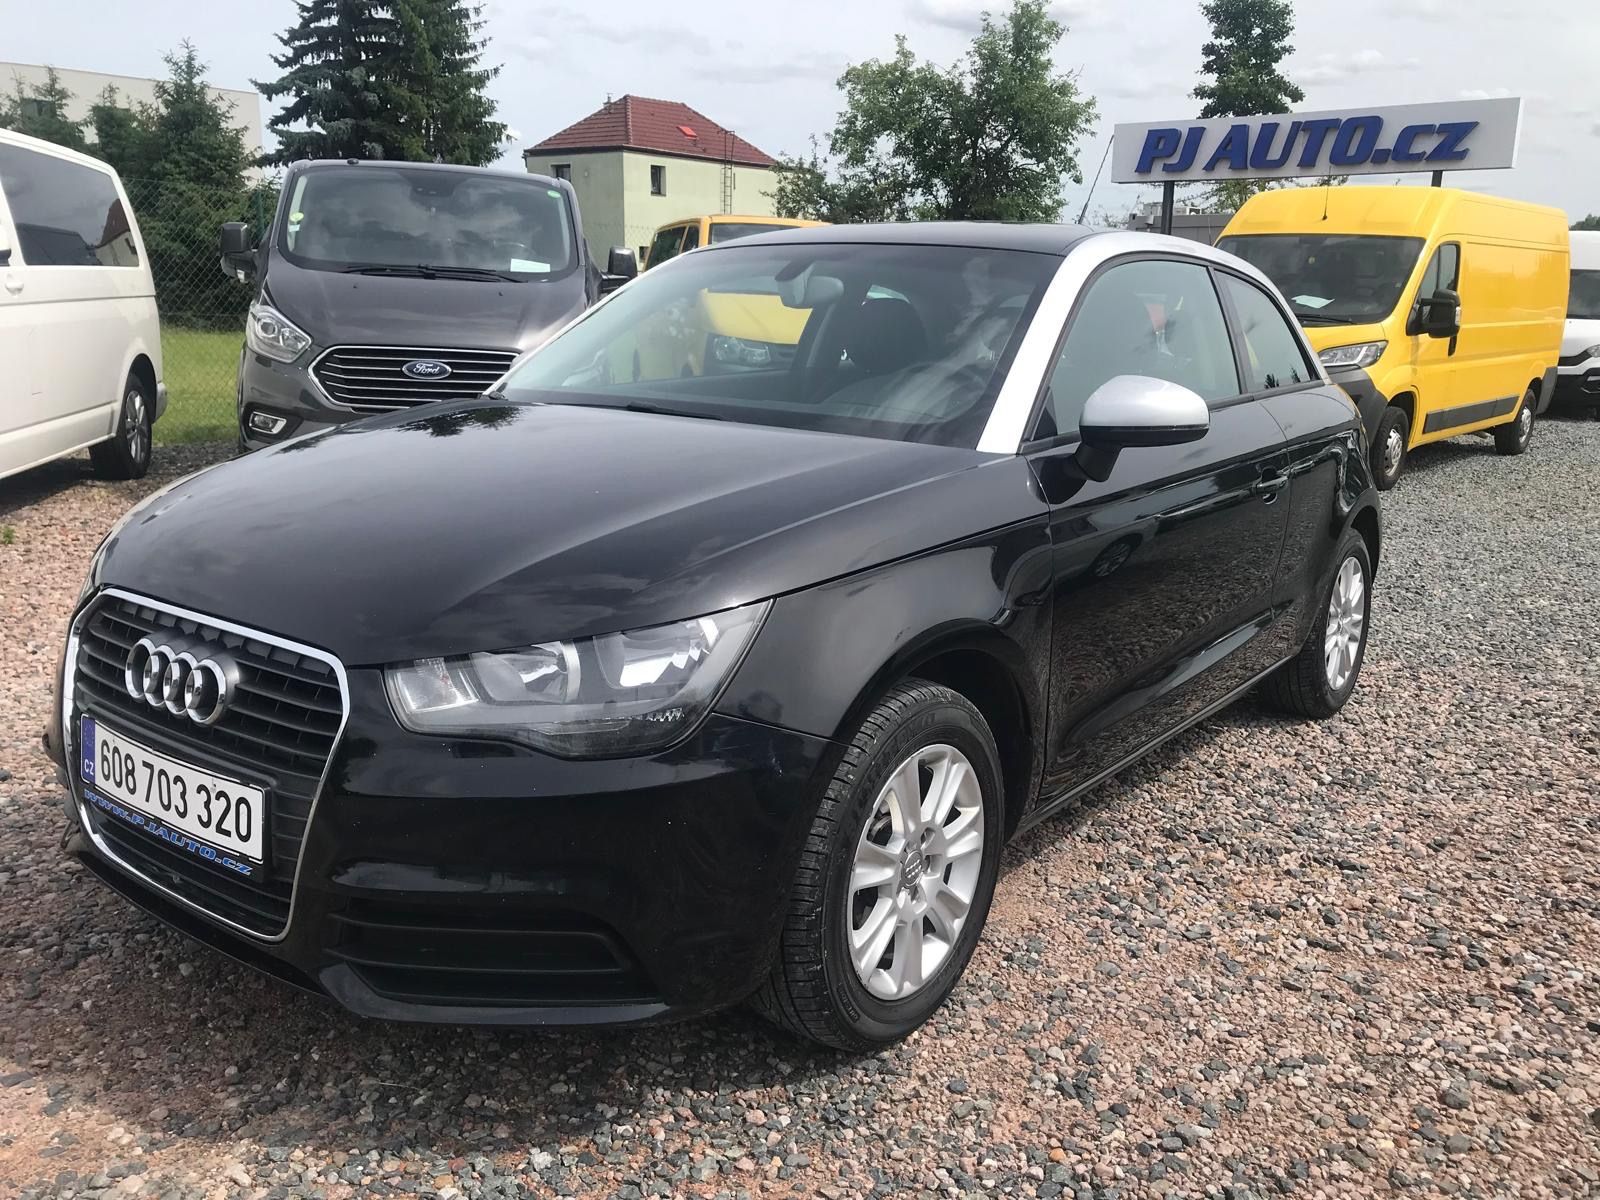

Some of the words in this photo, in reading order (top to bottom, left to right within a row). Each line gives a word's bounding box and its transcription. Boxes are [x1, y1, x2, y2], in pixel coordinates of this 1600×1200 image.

[1135, 126, 1205, 173] PJ
[413, 362, 440, 374] Ford
[84, 758, 94, 775] CZ
[101, 739, 137, 795] 608
[142, 760, 188, 819] 703
[196, 783, 252, 843] 320
